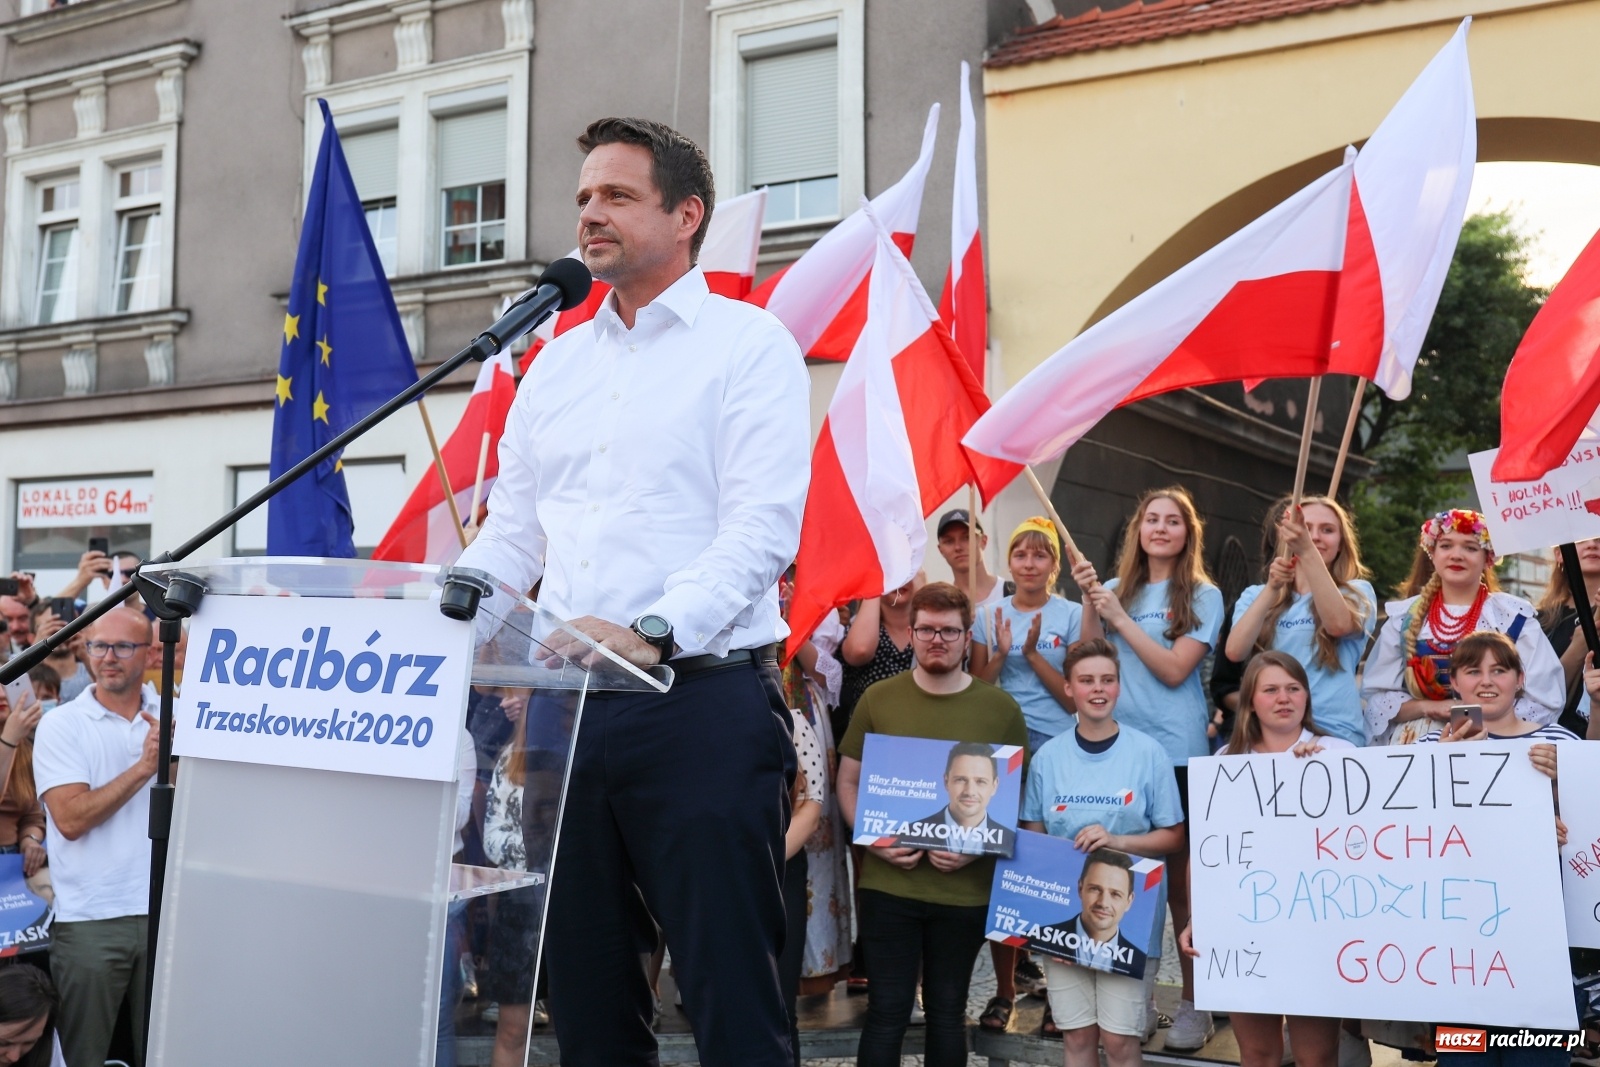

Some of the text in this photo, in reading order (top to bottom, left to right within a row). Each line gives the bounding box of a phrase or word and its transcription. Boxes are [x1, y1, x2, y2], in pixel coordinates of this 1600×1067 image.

[22, 488, 72, 504] LOKAL
[78, 486, 98, 500] DO
[22, 502, 97, 519] WYNAJĘCIA
[200, 626, 447, 697] Racibórz
[195, 701, 434, 748] Trzaskowski2020
[867, 784, 938, 800] Wspólna Polska
[868, 774, 937, 789] Silny Prezydent
[864, 809, 888, 819] RAFAŁ
[862, 817, 1004, 845] TRZASKOWSKI
[1199, 824, 1472, 869] CIĘ KOCHA
[1001, 880, 1071, 905] Wspólna Polska
[1003, 869, 1071, 894] Silny Prezydent
[996, 905, 1020, 917] RAFAŁ
[1238, 869, 1511, 936] BARDZIEJ
[0, 925, 49, 946] ZASK
[995, 912, 1134, 965] TRZASKOWSKI
[1207, 940, 1515, 988] NIŻ GOCHA
